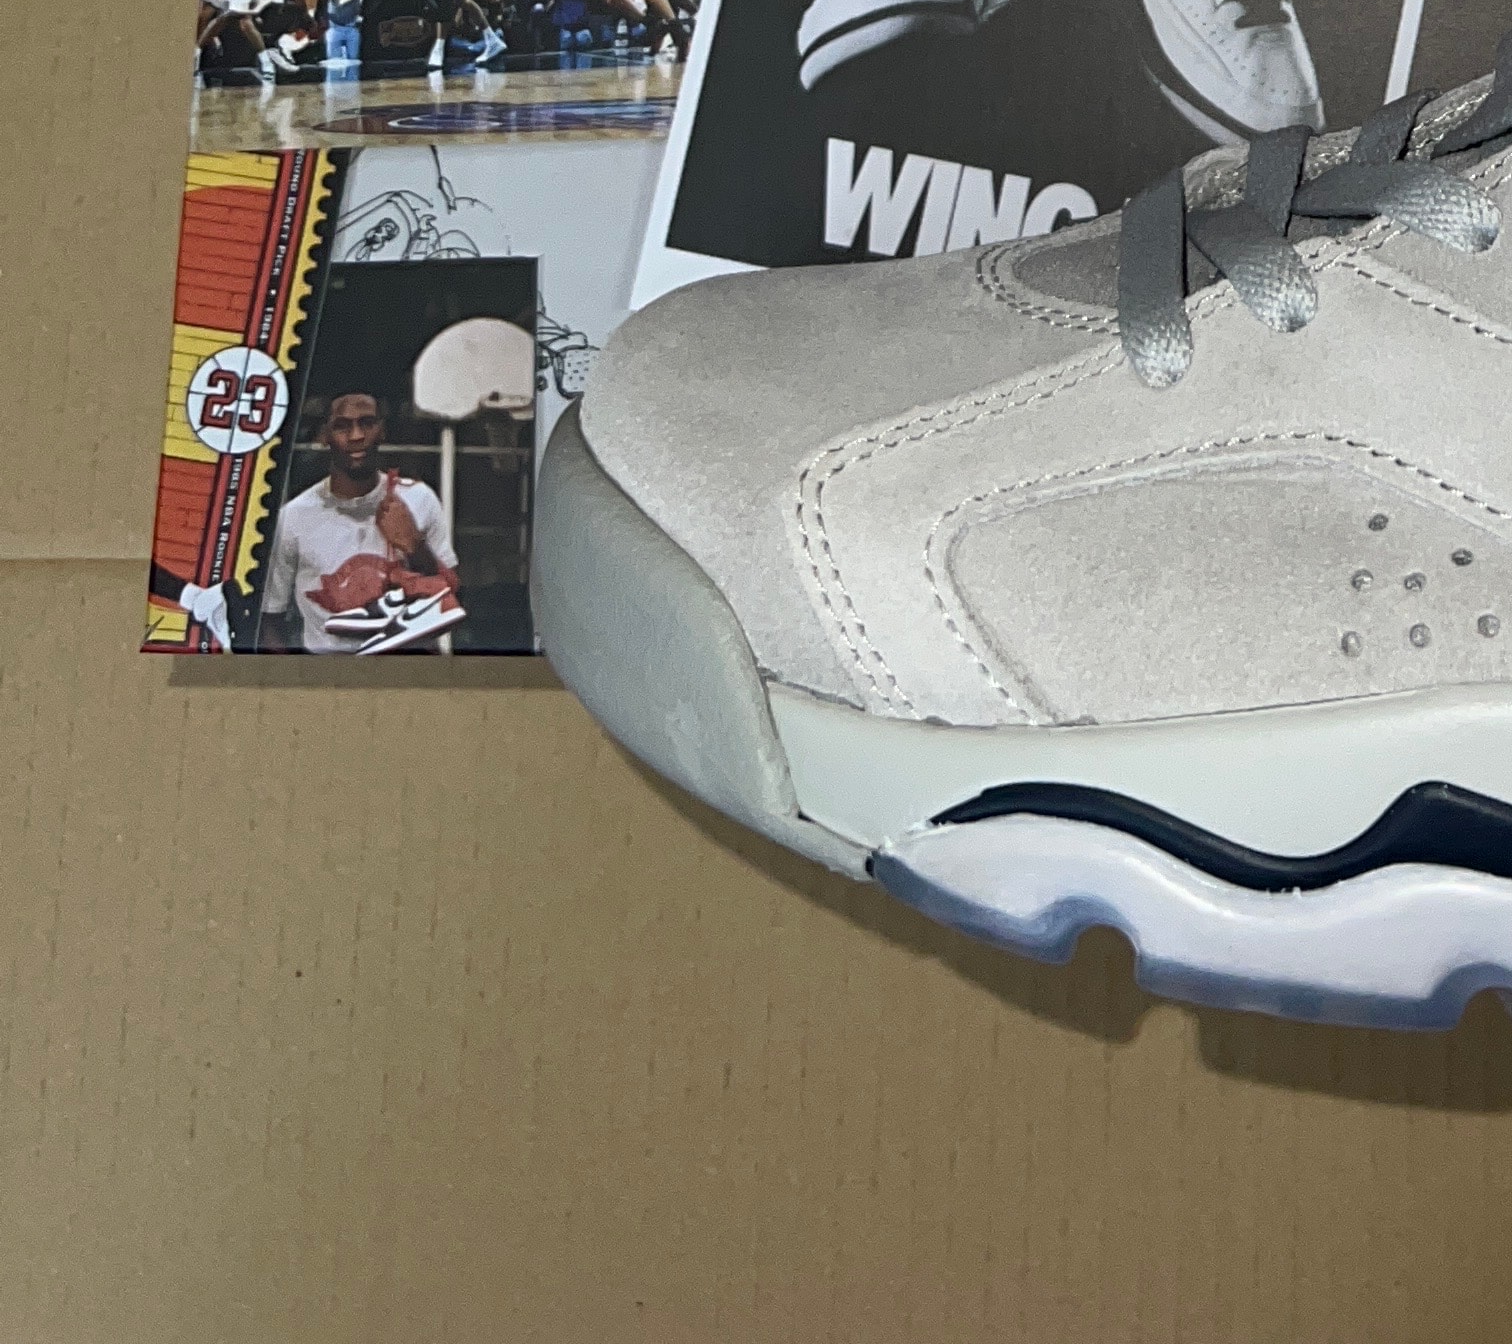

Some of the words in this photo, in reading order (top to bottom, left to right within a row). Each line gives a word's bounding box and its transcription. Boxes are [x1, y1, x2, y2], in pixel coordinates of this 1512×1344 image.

[200, 368, 277, 434] 23
[222, 494, 236, 528] NBA
[212, 532, 228, 582] ROOKIE
